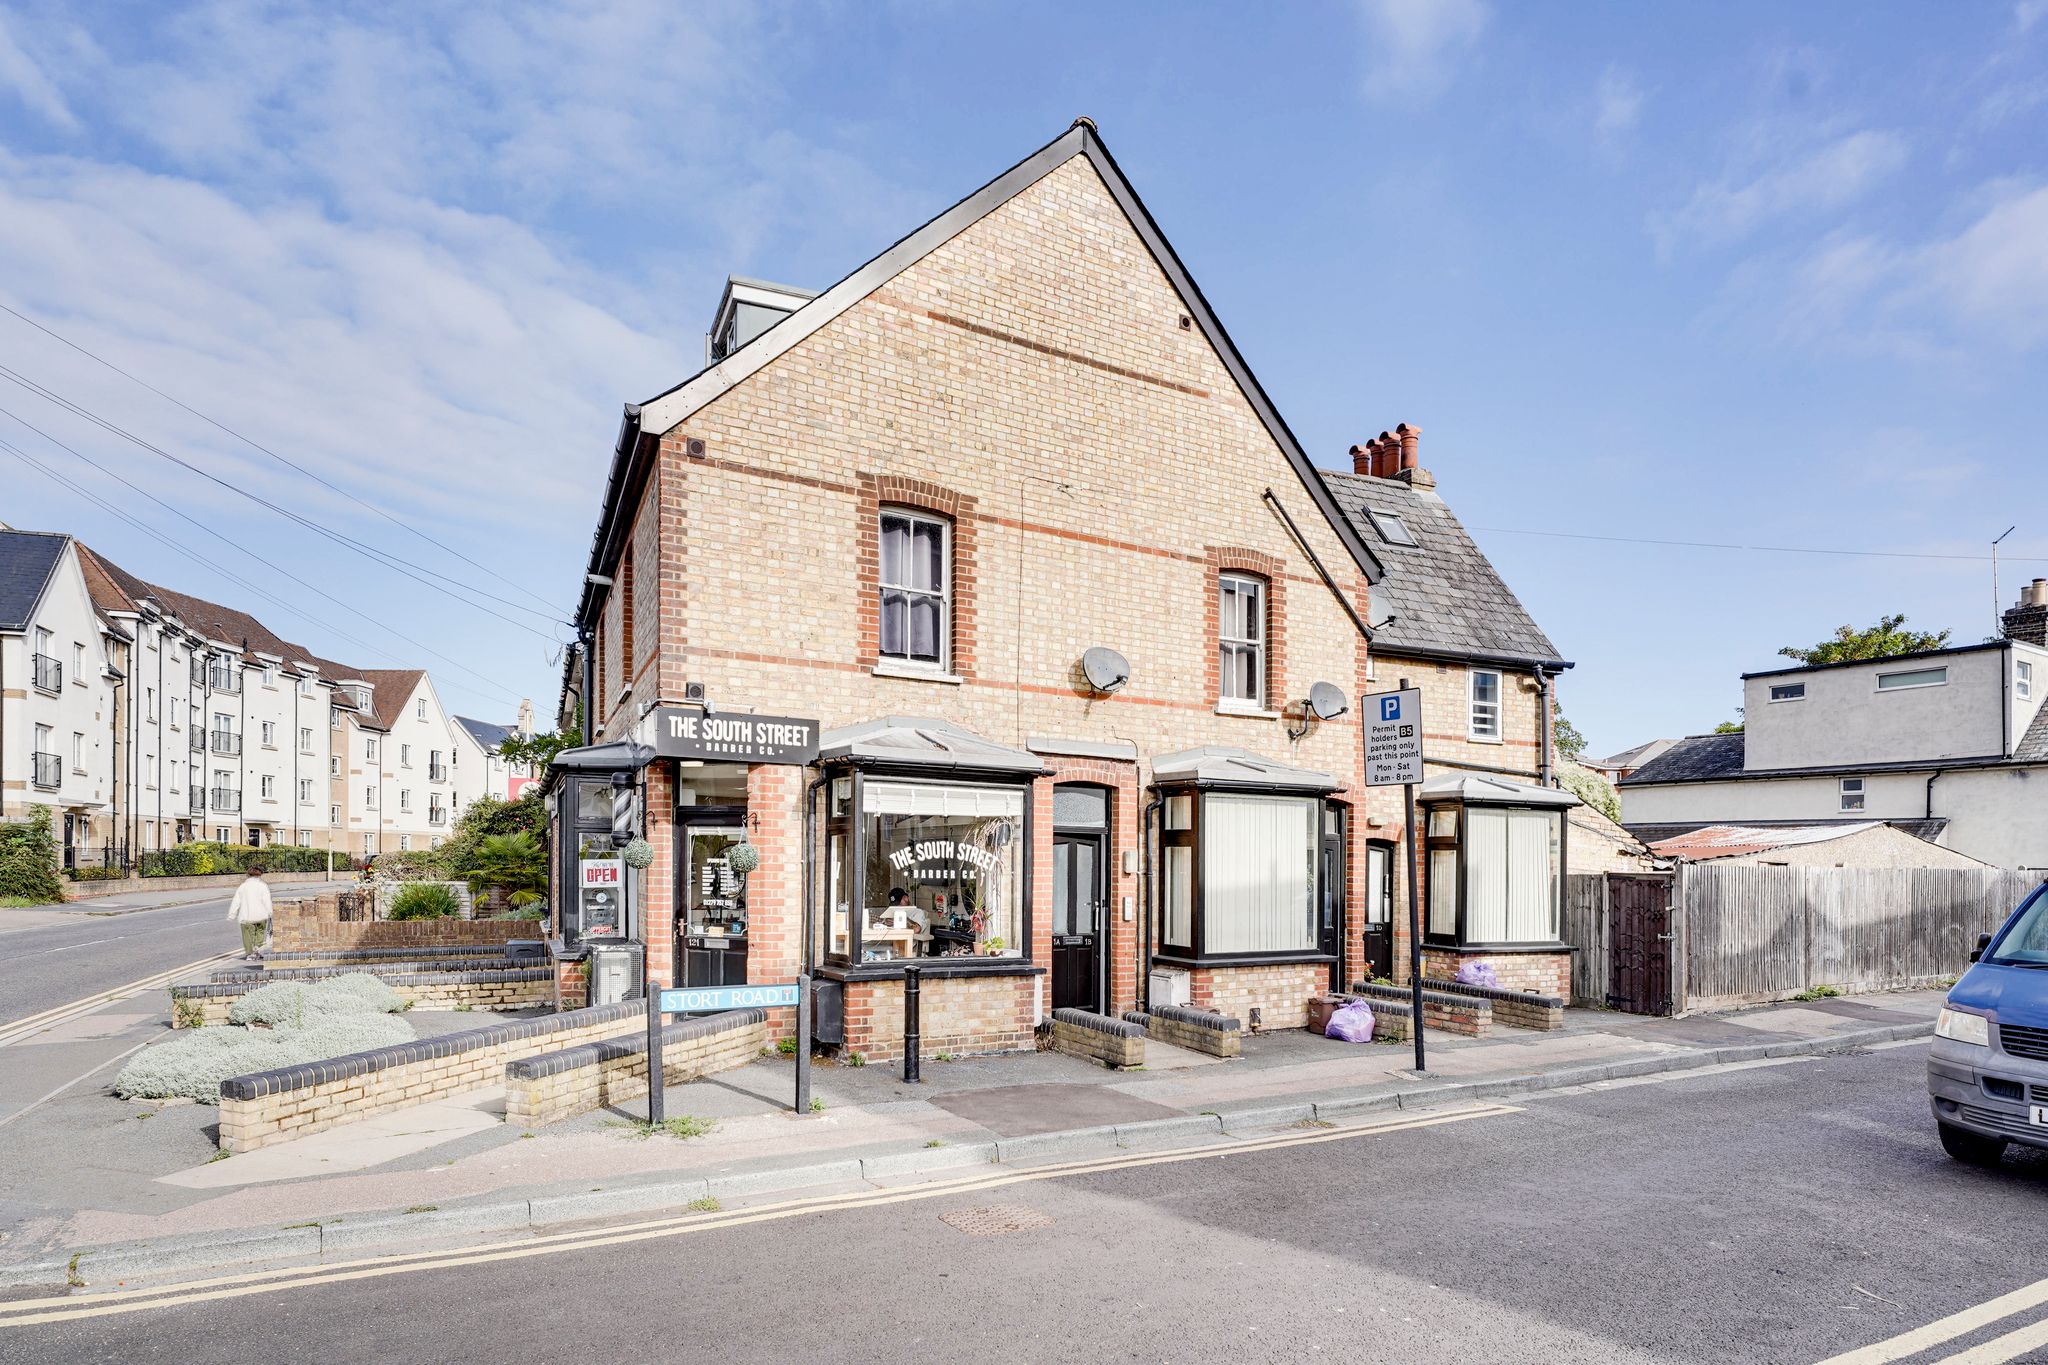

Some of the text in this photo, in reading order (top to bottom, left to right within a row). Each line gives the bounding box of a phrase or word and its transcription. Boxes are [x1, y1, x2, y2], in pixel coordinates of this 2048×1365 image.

[1385, 699, 1398, 719] P
[669, 715, 810, 747] THE SOUTH STREET
[1372, 724, 1413, 736] Permit B5
[1371, 734, 1397, 743] holders
[706, 742, 775, 756] BARBER CO.
[1370, 741, 1415, 753] parking only
[1367, 750, 1419, 762] past this point
[1376, 764, 1392, 772] Mon
[1397, 762, 1410, 770] Sat
[889, 840, 999, 872] THE SOUTH STREET
[587, 868, 617, 882] OPEN
[913, 869, 977, 879] BARBER CO.
[667, 989, 778, 1009] STORT ROAD
